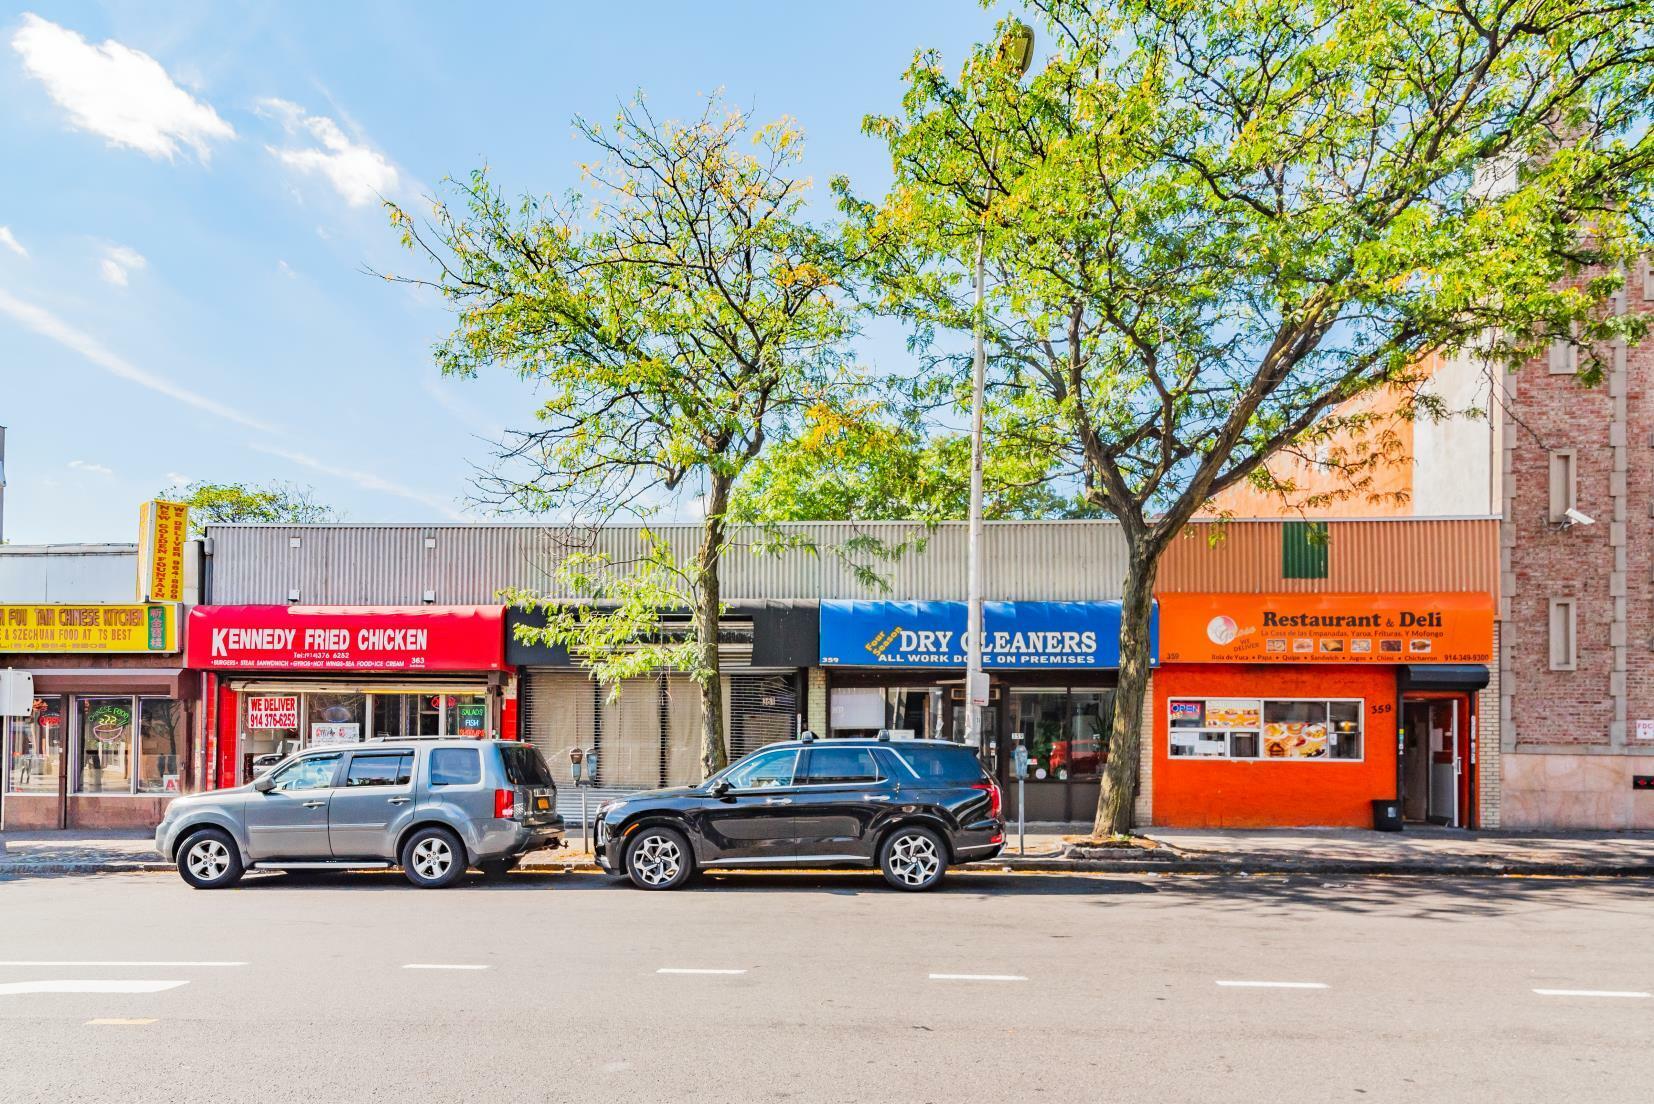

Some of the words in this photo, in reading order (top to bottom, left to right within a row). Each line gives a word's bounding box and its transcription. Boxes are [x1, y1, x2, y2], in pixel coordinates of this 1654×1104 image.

[59, 608, 100, 626] CHINESE
[103, 608, 144, 626] KITCHEN
[1263, 611, 1381, 627] Restaurant
[1385, 617, 1395, 627] &
[1400, 611, 1443, 627] Deli
[12, 628, 55, 641] SZECHUAN
[59, 629, 79, 641] FOOD
[82, 628, 92, 641] AT
[111, 628, 133, 641] BEST
[864, 630, 886, 652] Four
[871, 625, 903, 657] Season
[899, 630, 954, 653] DRY
[211, 628, 297, 657] KENNEDY
[304, 628, 351, 651] FRIED
[357, 628, 428, 651] CHICKEN
[878, 654, 904, 662] ALL
[907, 654, 949, 663] WORK
[953, 655, 992, 663] DE
[997, 655, 1016, 663] ON
[1021, 655, 1095, 664] PREMISES
[251, 698, 263, 711] WE
[264, 698, 296, 711] DELIVER
[1172, 704, 1200, 713] OPEN
[1371, 703, 1392, 714] 359
[250, 713, 264, 727] 914
[264, 713, 296, 727] 376-6252
[465, 719, 479, 727] FISH
